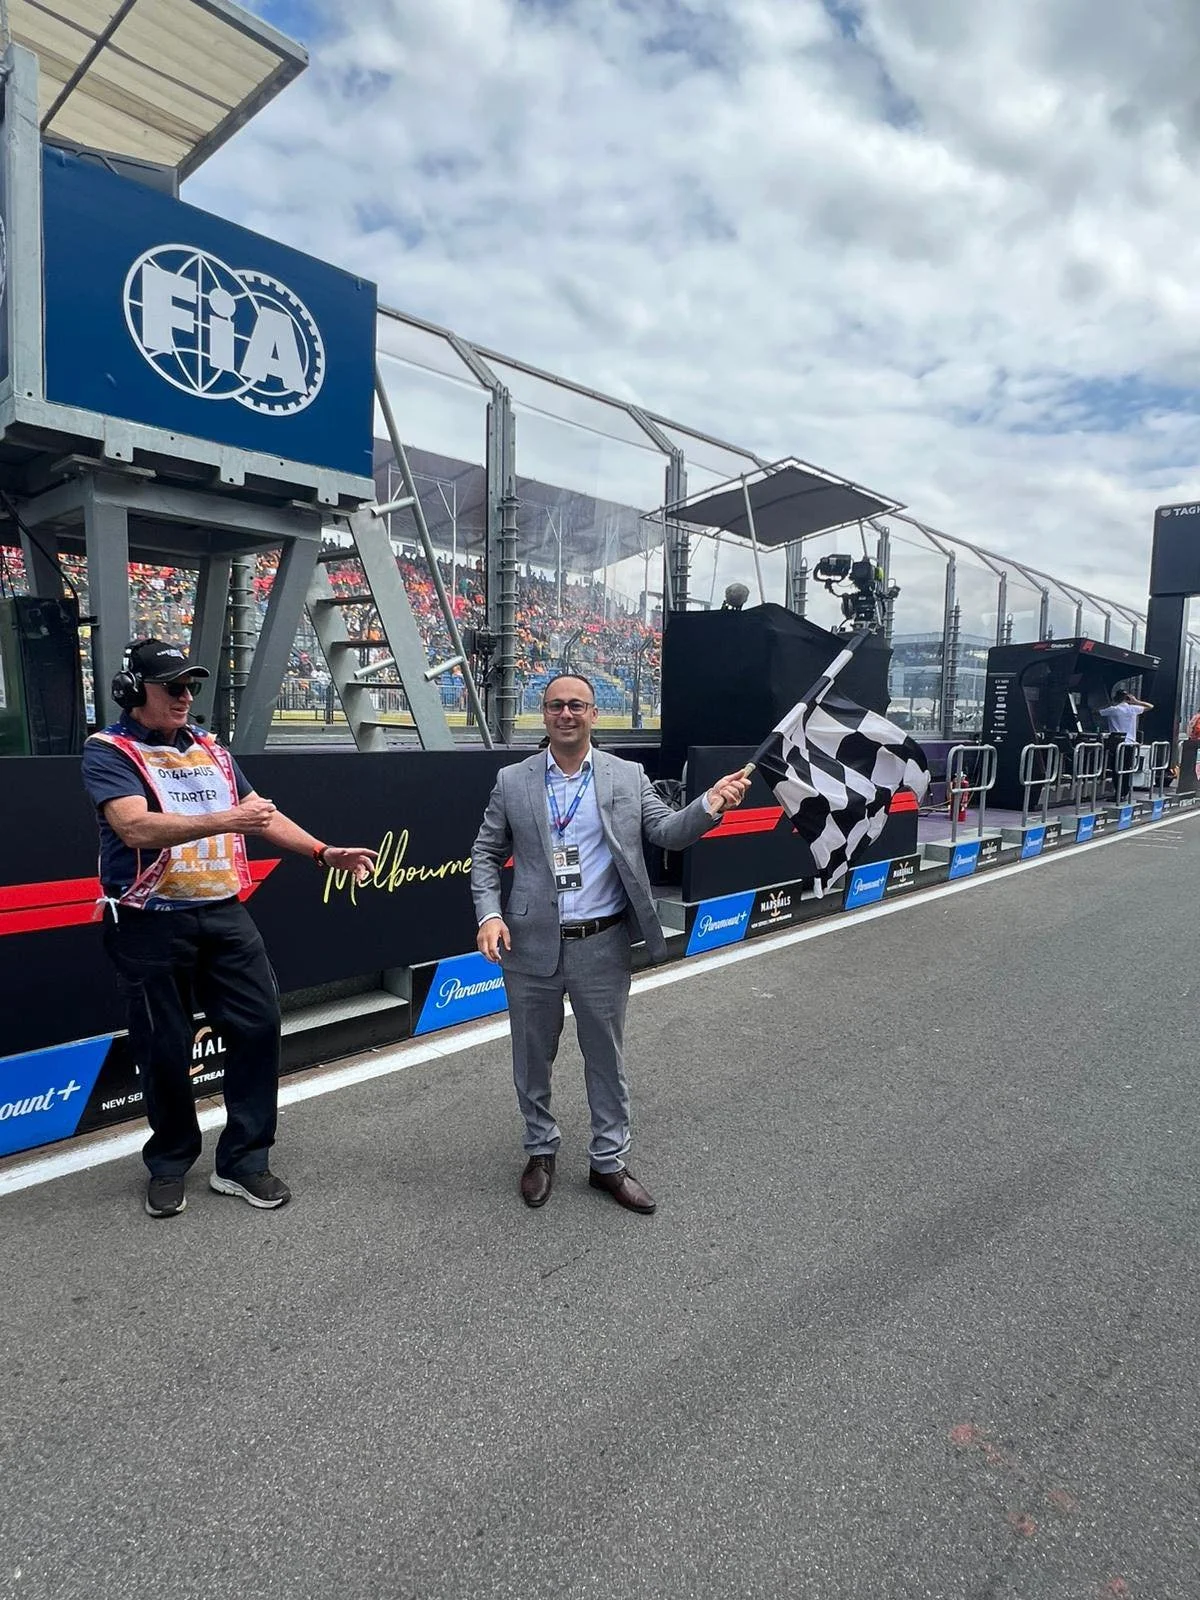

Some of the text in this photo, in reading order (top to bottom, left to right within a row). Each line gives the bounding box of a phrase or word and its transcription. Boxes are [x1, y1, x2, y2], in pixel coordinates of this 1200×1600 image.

[323, 829, 472, 906] Melbourne
[697, 910, 748, 938] Paramount+
[102, 1096, 126, 1111] NEW
